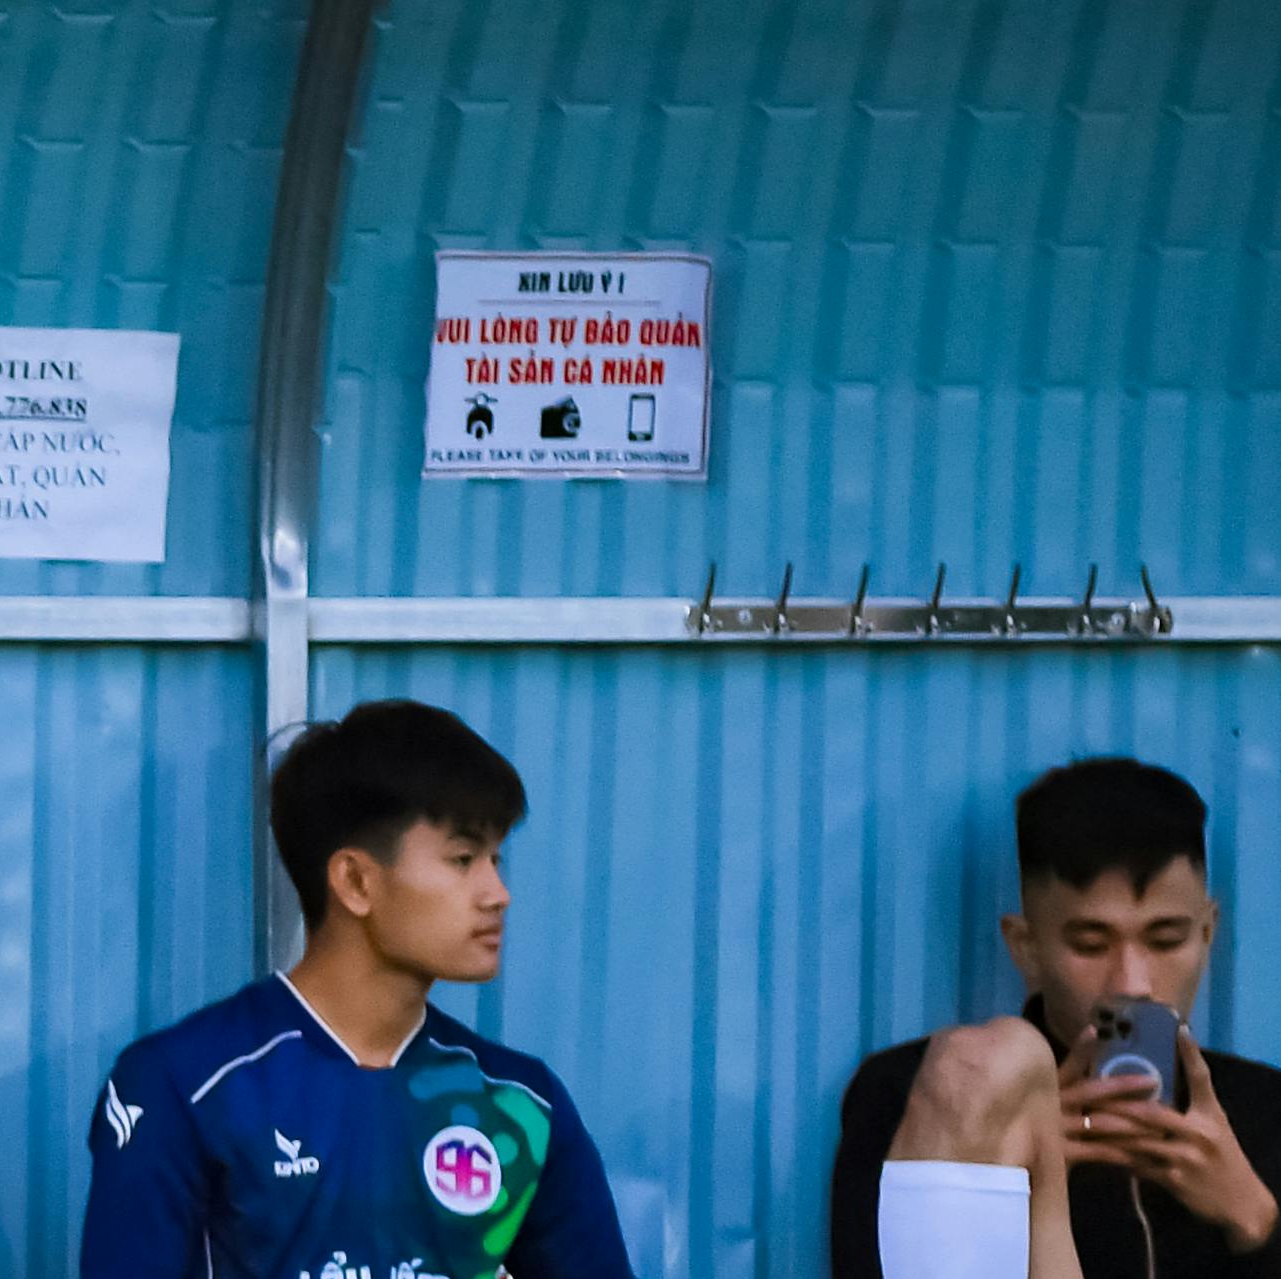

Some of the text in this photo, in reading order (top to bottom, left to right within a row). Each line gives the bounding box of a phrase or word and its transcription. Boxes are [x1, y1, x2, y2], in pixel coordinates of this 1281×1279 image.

[518, 271, 551, 294] XIN
[557, 270, 595, 294] LƯU
[480, 311, 539, 344] LÒNG
[549, 316, 577, 349] TỰ
[585, 310, 632, 345] BẢO
[640, 311, 702, 349] QUẢN
[465, 349, 665, 385] TÀI SẢN CÁ NHÂN
